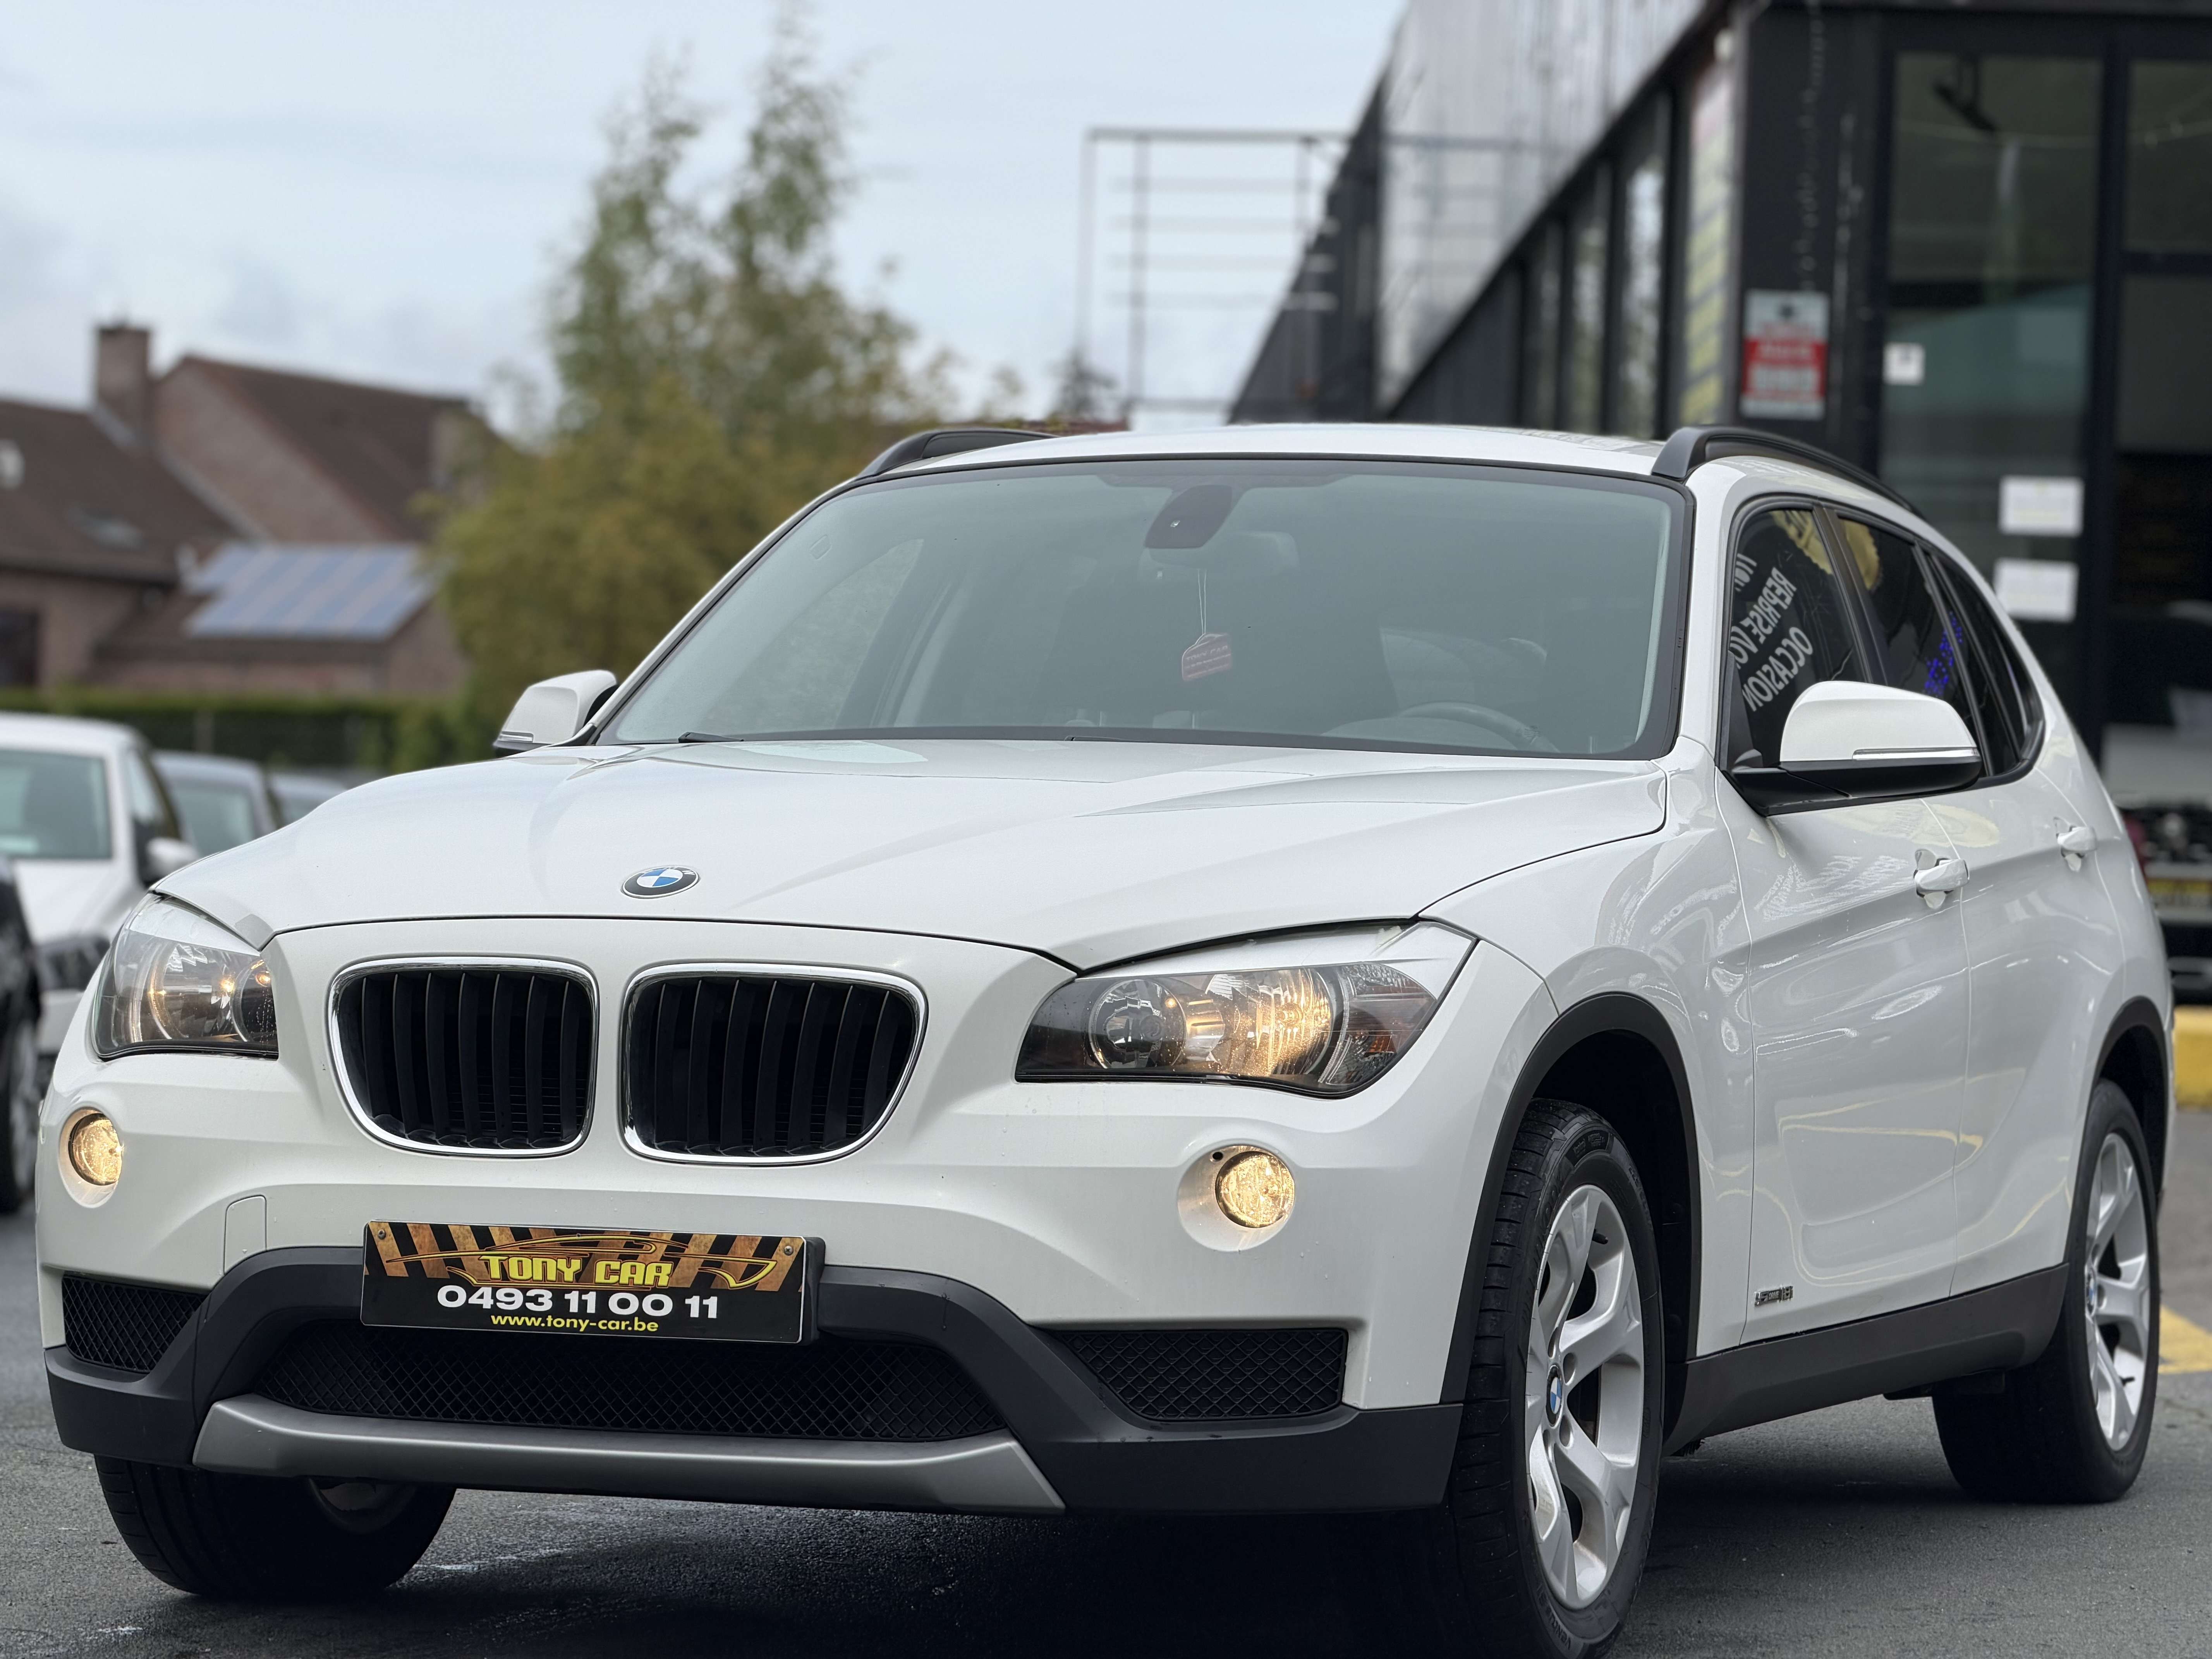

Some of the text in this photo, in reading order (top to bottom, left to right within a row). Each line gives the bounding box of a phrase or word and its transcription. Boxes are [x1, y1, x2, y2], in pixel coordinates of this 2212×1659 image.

[478, 1255, 673, 1287] TONY CAR
[437, 1285, 718, 1319] 0493 11 00 11
[491, 1315, 659, 1332] www.tony-car.be
